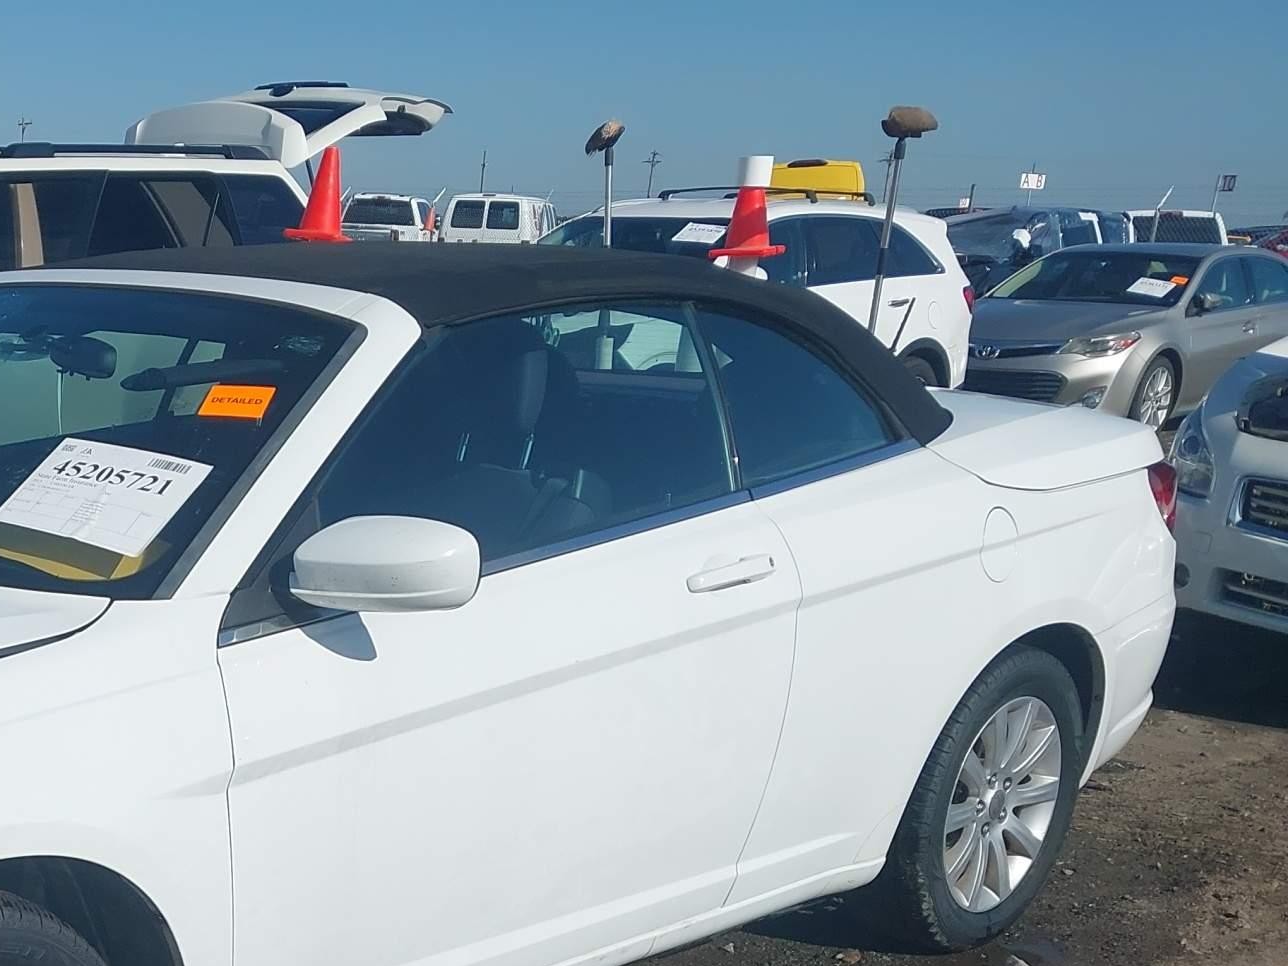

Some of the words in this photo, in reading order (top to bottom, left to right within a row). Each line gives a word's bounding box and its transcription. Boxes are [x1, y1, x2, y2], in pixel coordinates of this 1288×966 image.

[1022, 174, 1030, 187] A
[211, 396, 263, 405] DETAILED
[53, 459, 173, 495] 45205721
